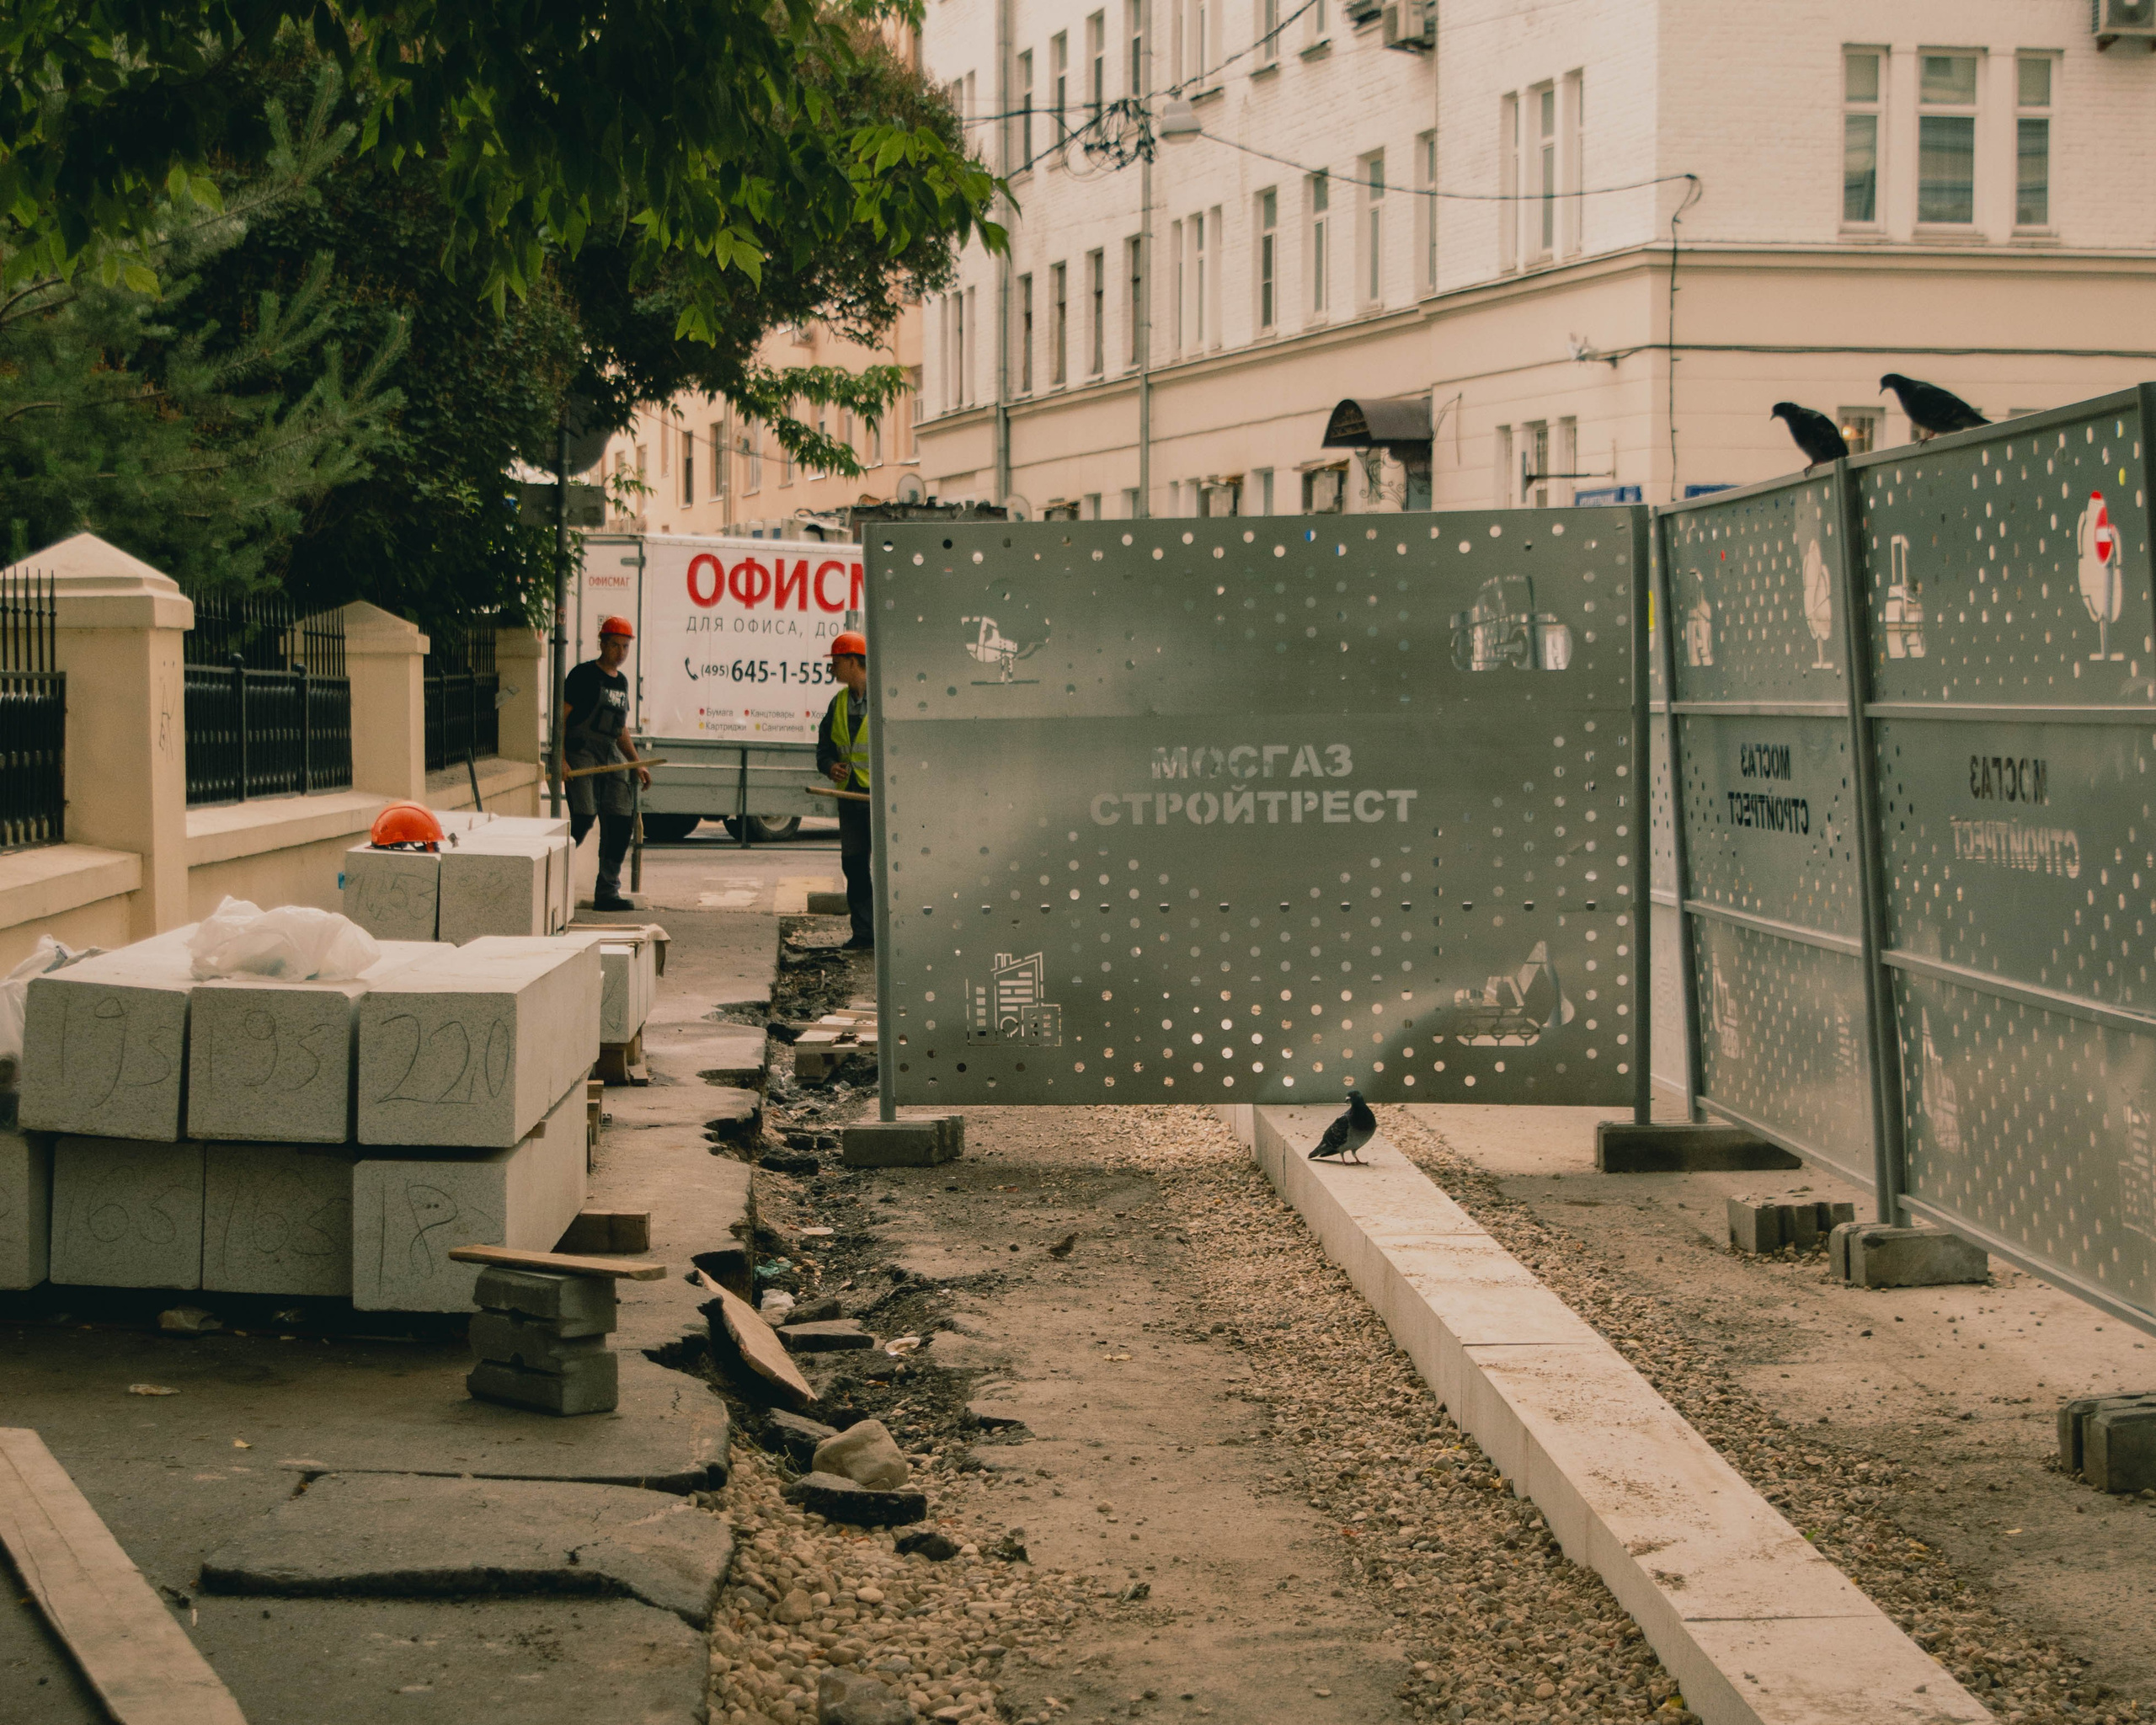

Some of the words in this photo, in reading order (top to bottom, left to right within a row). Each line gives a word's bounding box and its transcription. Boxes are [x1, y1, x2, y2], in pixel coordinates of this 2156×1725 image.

[589, 576, 631, 588] ОФИСМАГ
[686, 617, 723, 633] ДЛЯ
[734, 618, 803, 638] ОФИСА,
[815, 622, 846, 638] ДО
[701, 664, 729, 678] (495)
[731, 660, 836, 685] 645-1-555
[706, 708, 734, 718] Бумага
[750, 708, 795, 719] Канцтовары
[706, 722, 747, 733] Картриджи
[1151, 744, 1353, 779] МОСГАЗ
[1090, 785, 1417, 825] СТРОЙТРЕСТ
